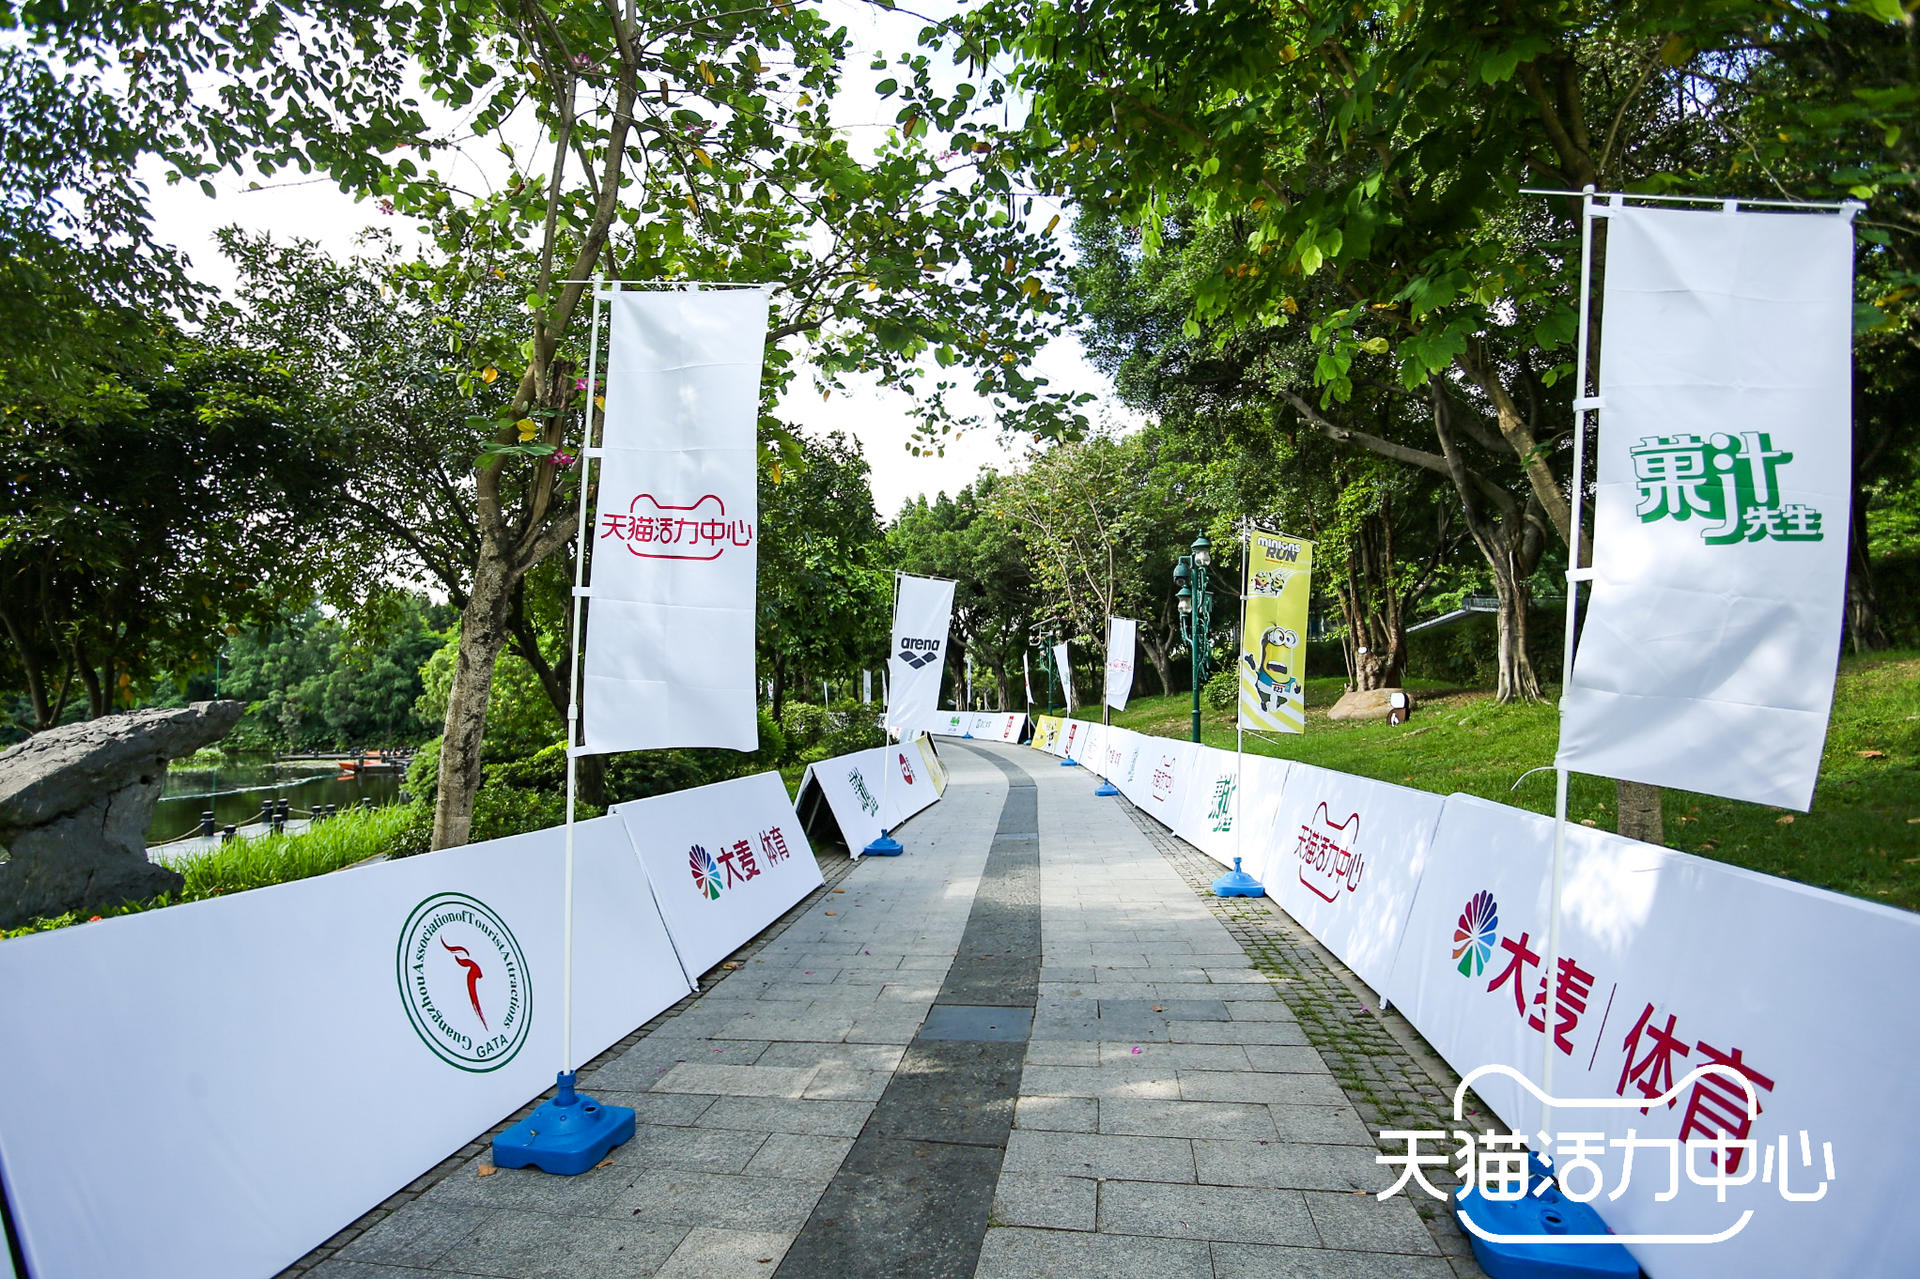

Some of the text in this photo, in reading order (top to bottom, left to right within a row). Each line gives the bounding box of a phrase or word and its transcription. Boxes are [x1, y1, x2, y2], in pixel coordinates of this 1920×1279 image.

[600, 513, 753, 547] 天猫活力中心
[1265, 547, 1298, 563] RUN
[900, 637, 941, 651] arena
[1293, 824, 1365, 893] 天猫活力中心
[475, 1034, 509, 1058] GATA
[1487, 931, 1775, 1175] 大麦 体育
